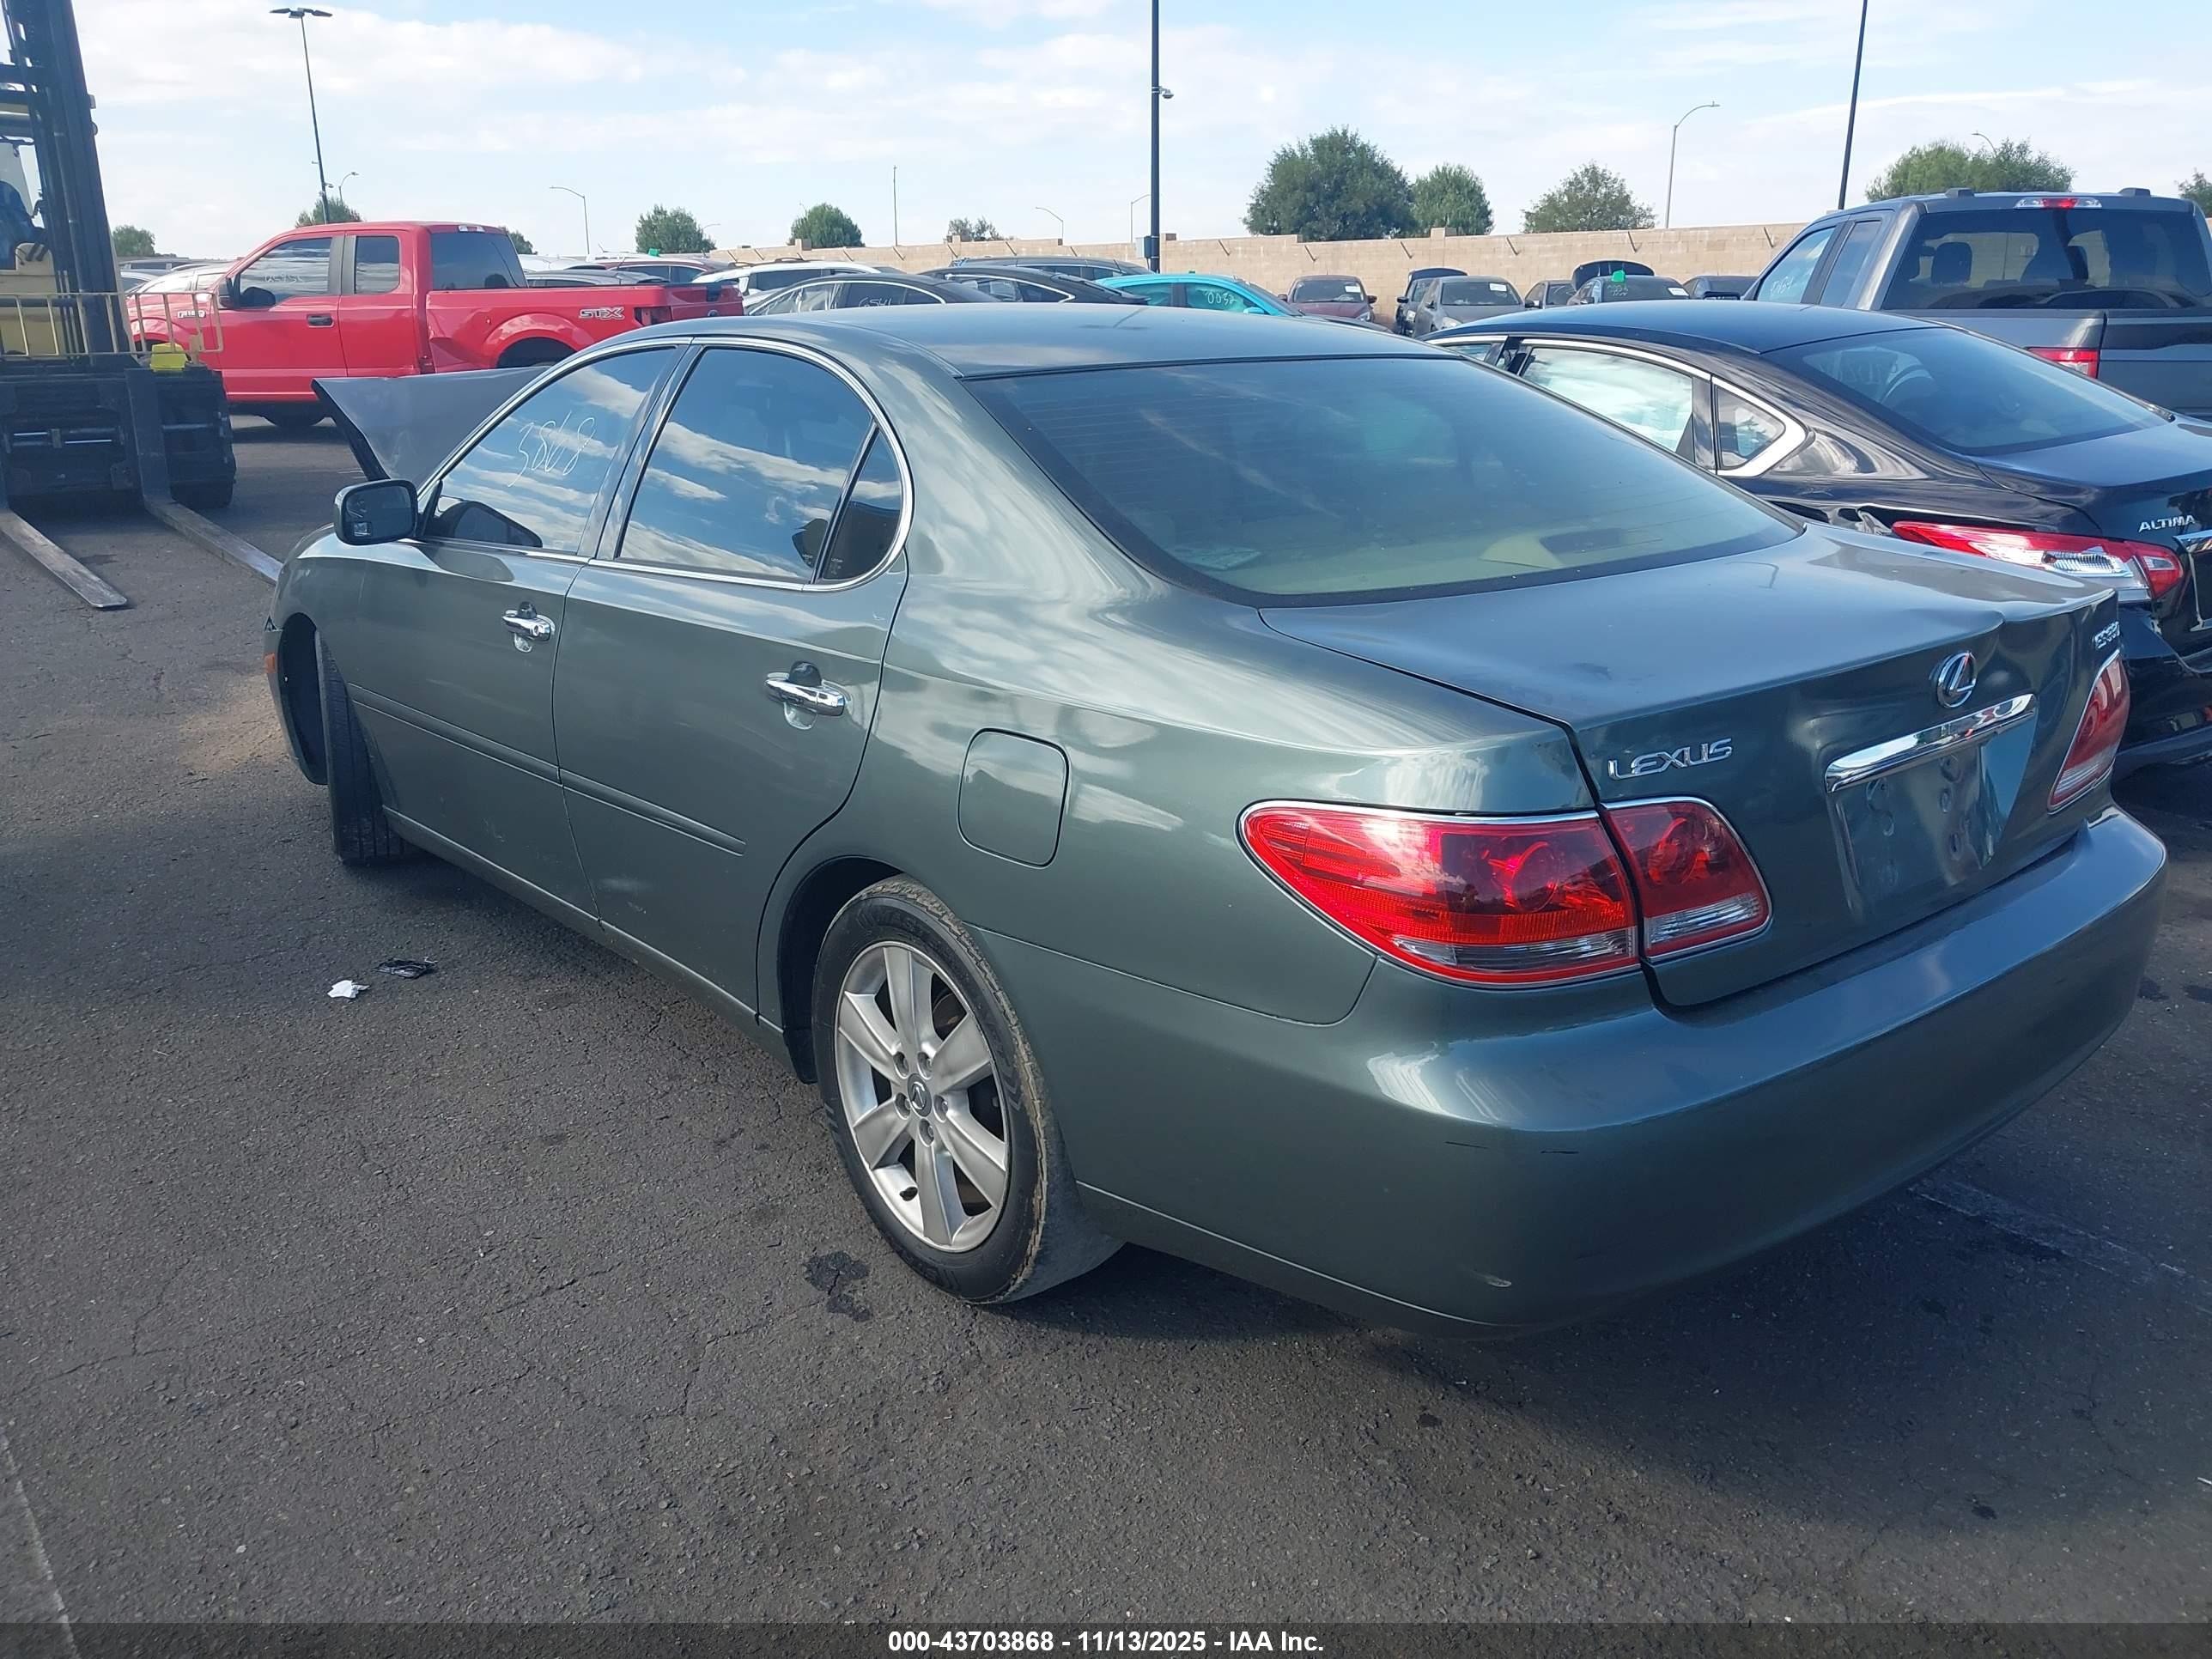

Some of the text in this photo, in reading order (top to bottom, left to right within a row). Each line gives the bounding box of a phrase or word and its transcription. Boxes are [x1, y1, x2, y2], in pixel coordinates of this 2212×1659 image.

[579, 307, 625, 320] STX
[2138, 514, 2196, 532] ALTIMA
[1607, 738, 1733, 781] LEXUS
